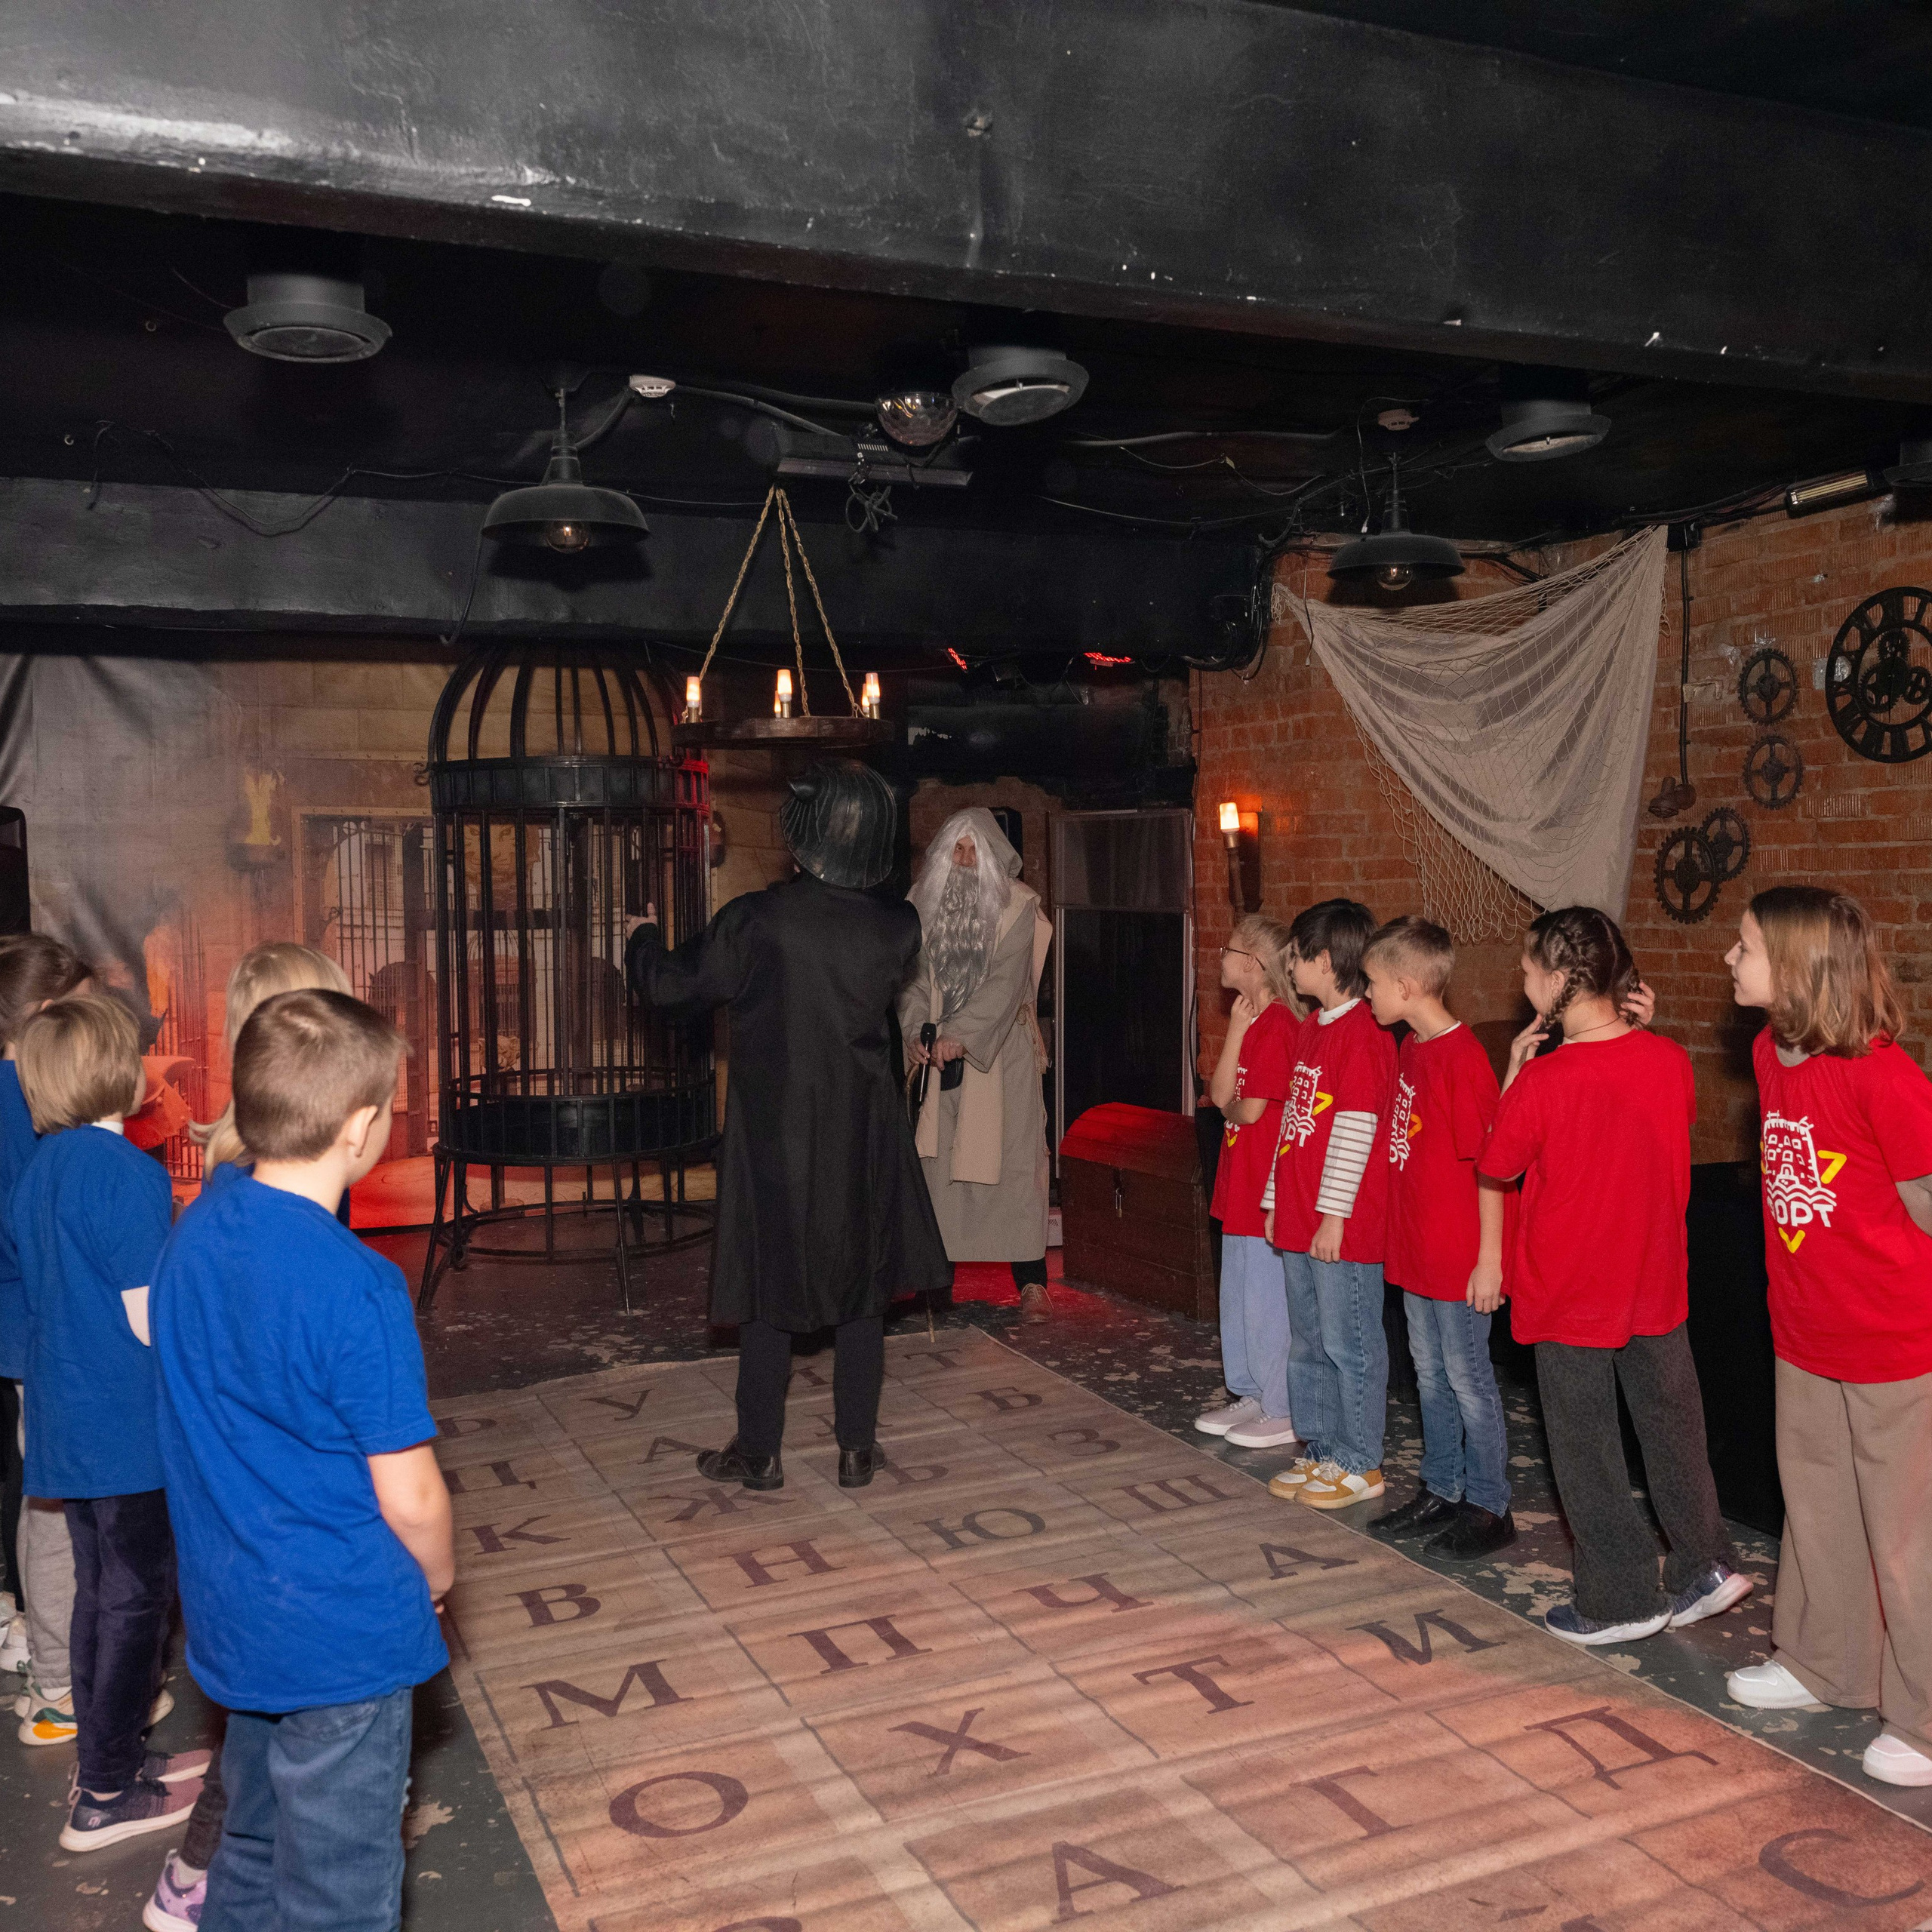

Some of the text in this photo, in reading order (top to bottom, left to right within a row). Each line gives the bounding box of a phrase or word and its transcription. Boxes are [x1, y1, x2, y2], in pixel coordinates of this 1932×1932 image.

[583, 1389, 655, 1421] У
[967, 1386, 1043, 1411] Б
[461, 1515, 571, 1555] К
[648, 1485, 795, 1523] Ж
[1047, 1428, 1121, 1457] З
[505, 1473, 1247, 1627] В Н Ю Ш
[520, 1542, 1358, 1730] М П Ч А
[608, 1609, 1507, 1838] О Х Т И
[1051, 1706, 1718, 1926] А Г Д
[1758, 1829, 1924, 1907] С
